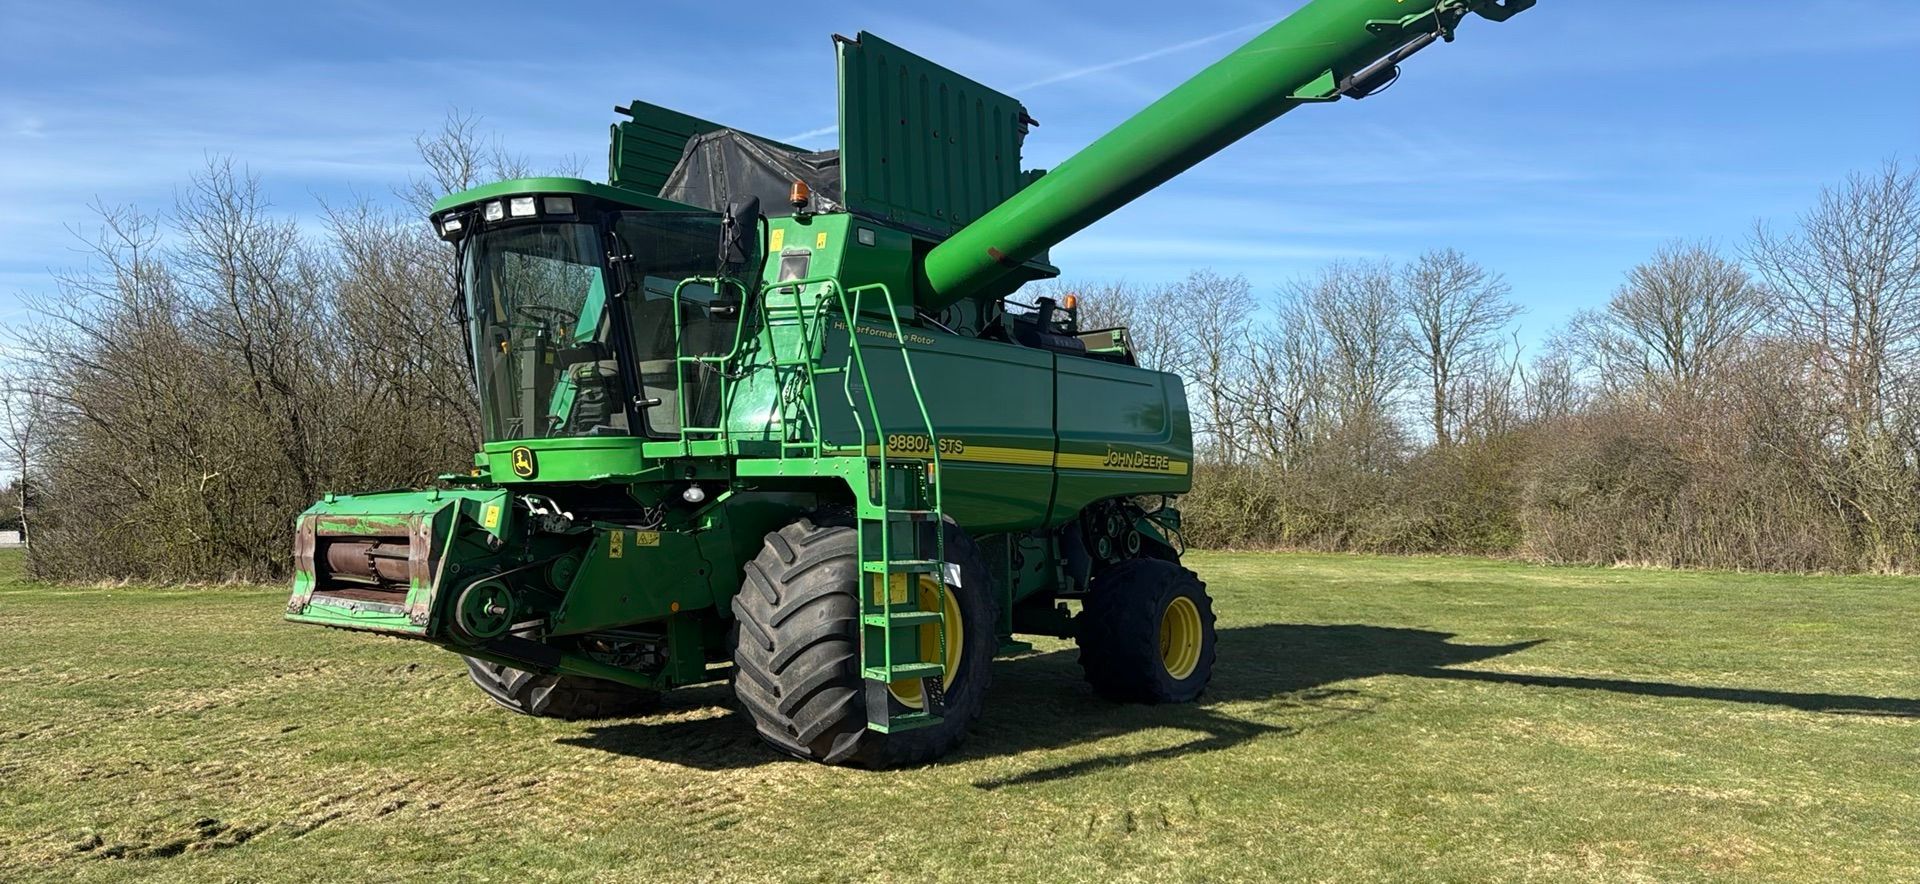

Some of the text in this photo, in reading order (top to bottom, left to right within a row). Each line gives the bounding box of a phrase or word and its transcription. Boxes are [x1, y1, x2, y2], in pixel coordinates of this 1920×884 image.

[834, 321, 935, 345] Hi-erformane Rotor
[889, 434, 963, 453] 9880i STS
[1104, 448, 1169, 470] JOHN DEERE
